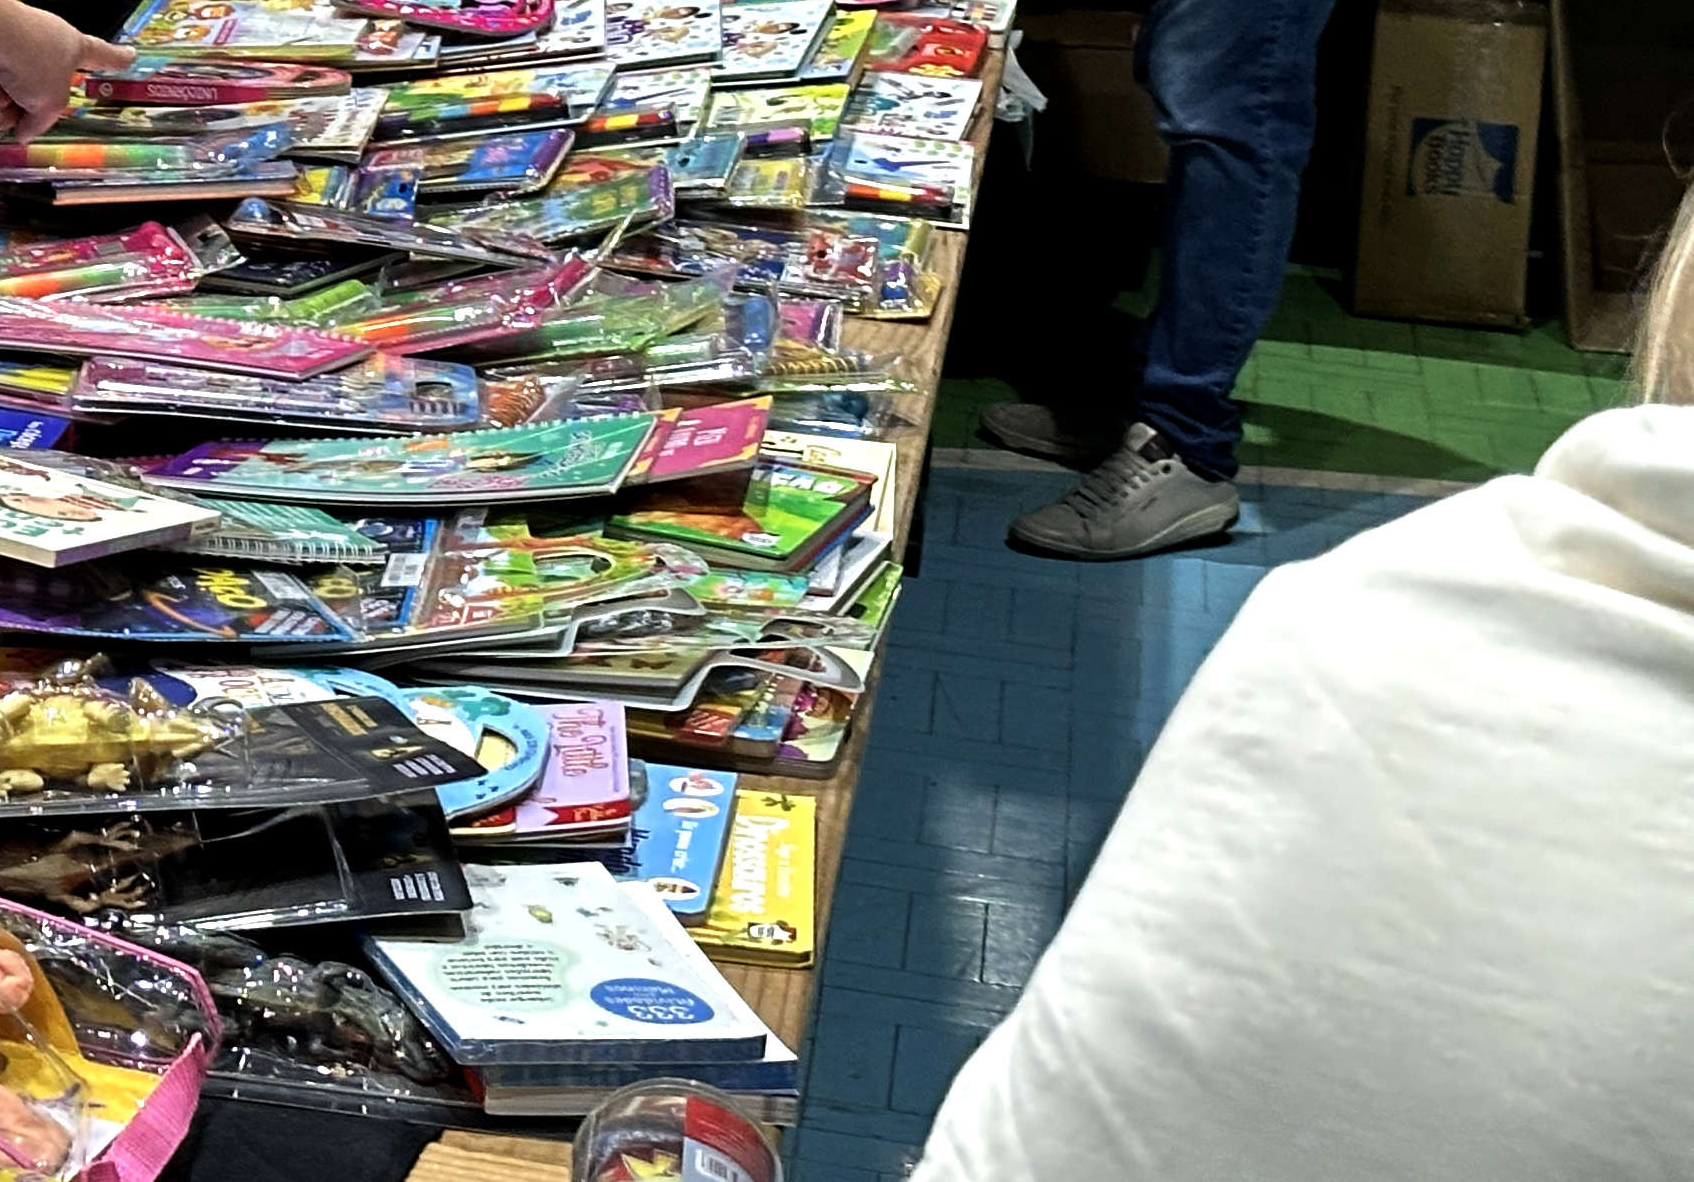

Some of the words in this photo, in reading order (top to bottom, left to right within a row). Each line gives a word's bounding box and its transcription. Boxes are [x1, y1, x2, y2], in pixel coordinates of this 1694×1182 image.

[553, 708, 606, 737] The
[553, 736, 611, 779] Little
[626, 1005, 695, 1021] 333
